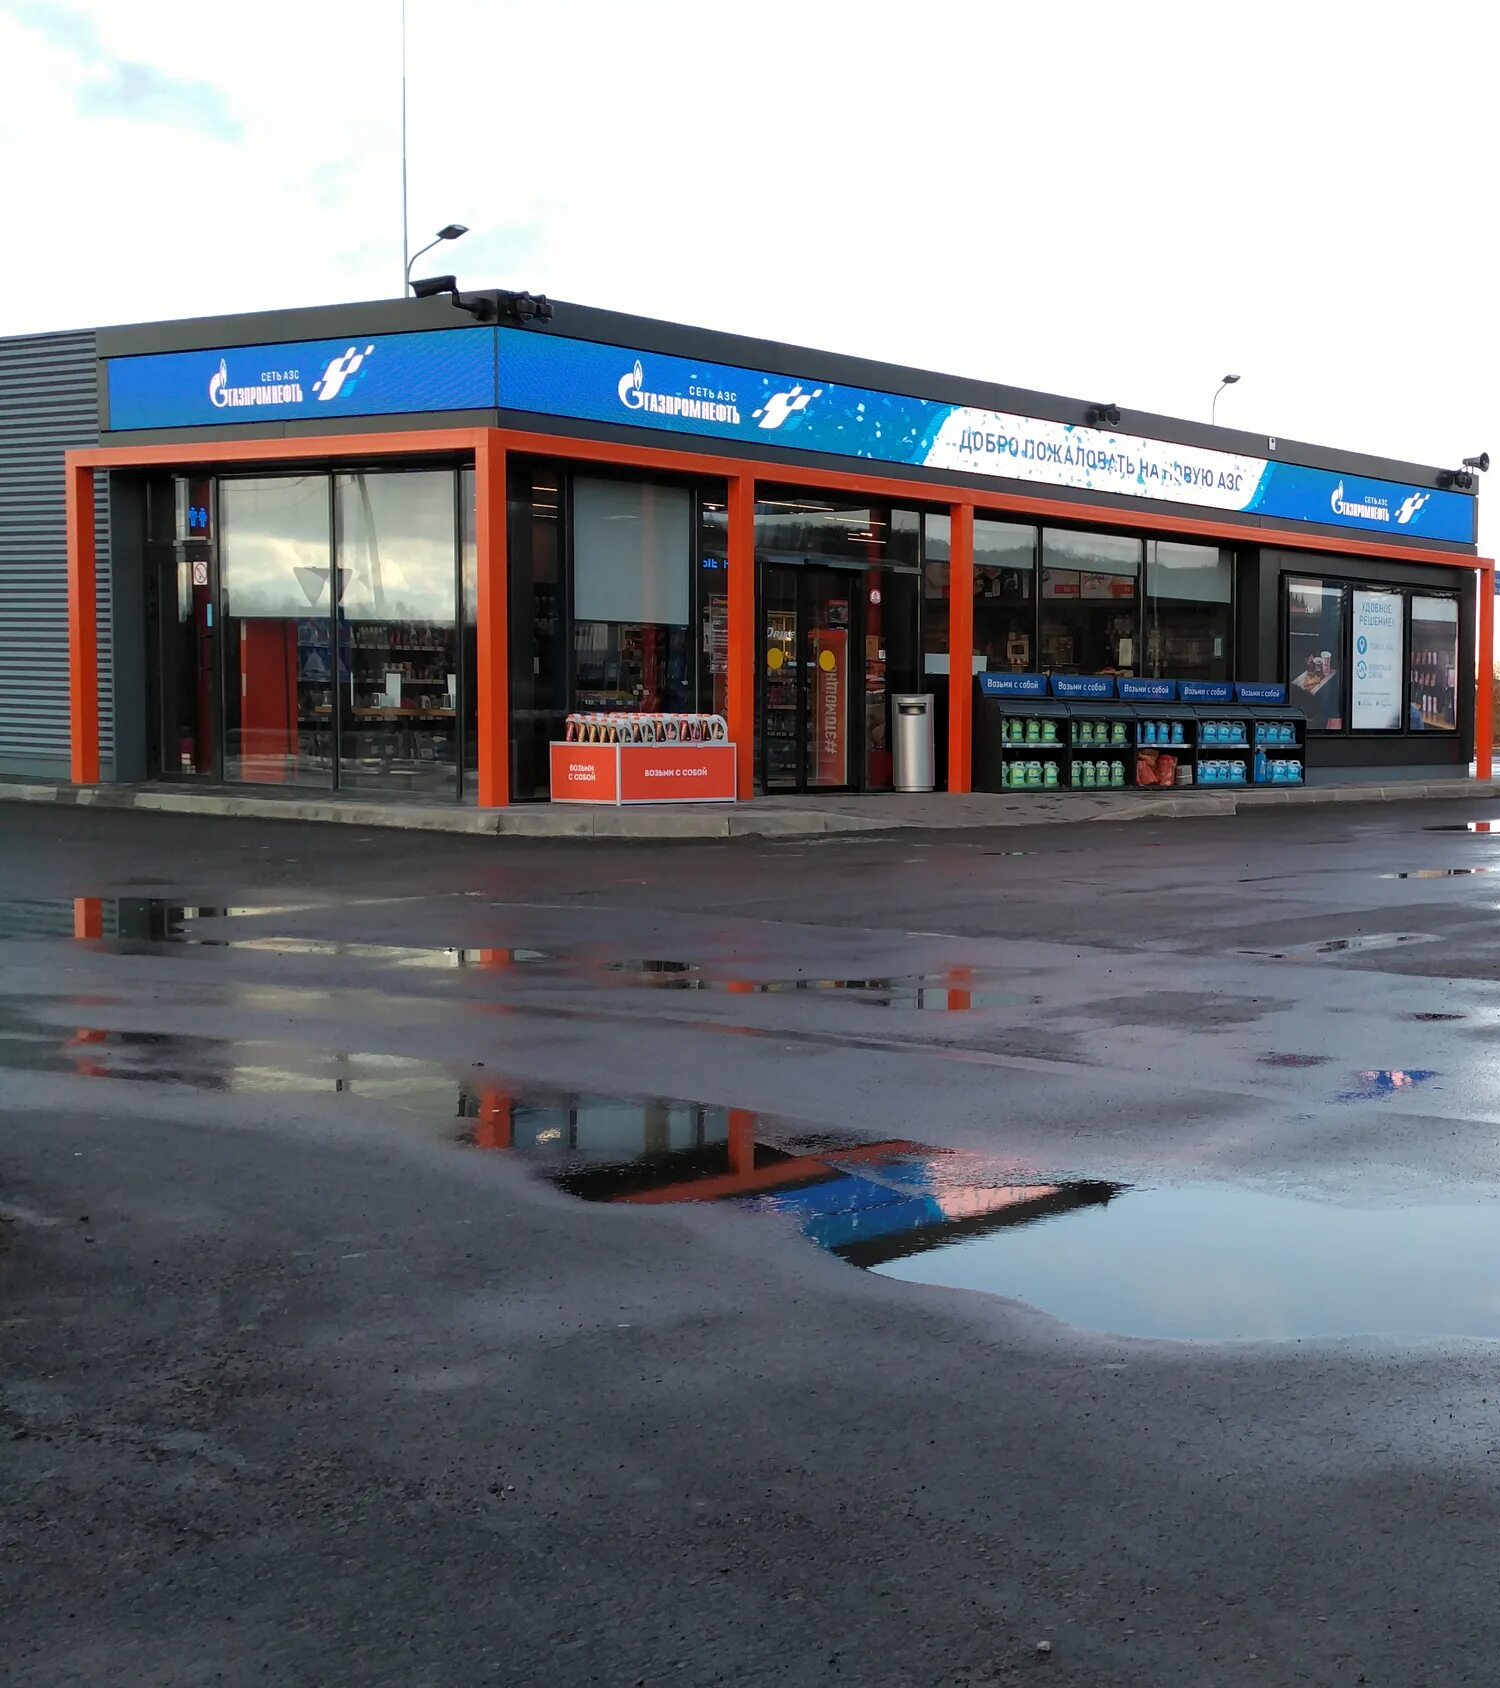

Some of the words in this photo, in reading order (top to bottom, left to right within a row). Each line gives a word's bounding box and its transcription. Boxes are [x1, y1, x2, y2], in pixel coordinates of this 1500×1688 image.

[261, 371, 282, 382] СЕТЬ
[283, 370, 300, 380] АЗС
[689, 385, 715, 399] СЕТЬ
[717, 390, 737, 402] АЗС
[643, 391, 740, 425] ГАЗПРОМНЕФТЬ
[959, 429, 1019, 456] ДОБРО
[1024, 439, 1135, 475] ПОЖАЛОВАТЬ
[1139, 458, 1159, 479] НА
[1217, 471, 1243, 492] АЗС
[1361, 601, 1393, 614] УДОБНОЕ
[987, 679, 1013, 688] Возьми
[1018, 680, 1039, 689] собой
[1058, 681, 1081, 691] Возьми
[1087, 682, 1106, 691] собой
[569, 764, 595, 772] ВОЗЬМИ
[644, 769, 674, 777] ВОЗЬМИ
[682, 767, 708, 777] СОБОЙ
[574, 772, 596, 782] СОБОЙ
